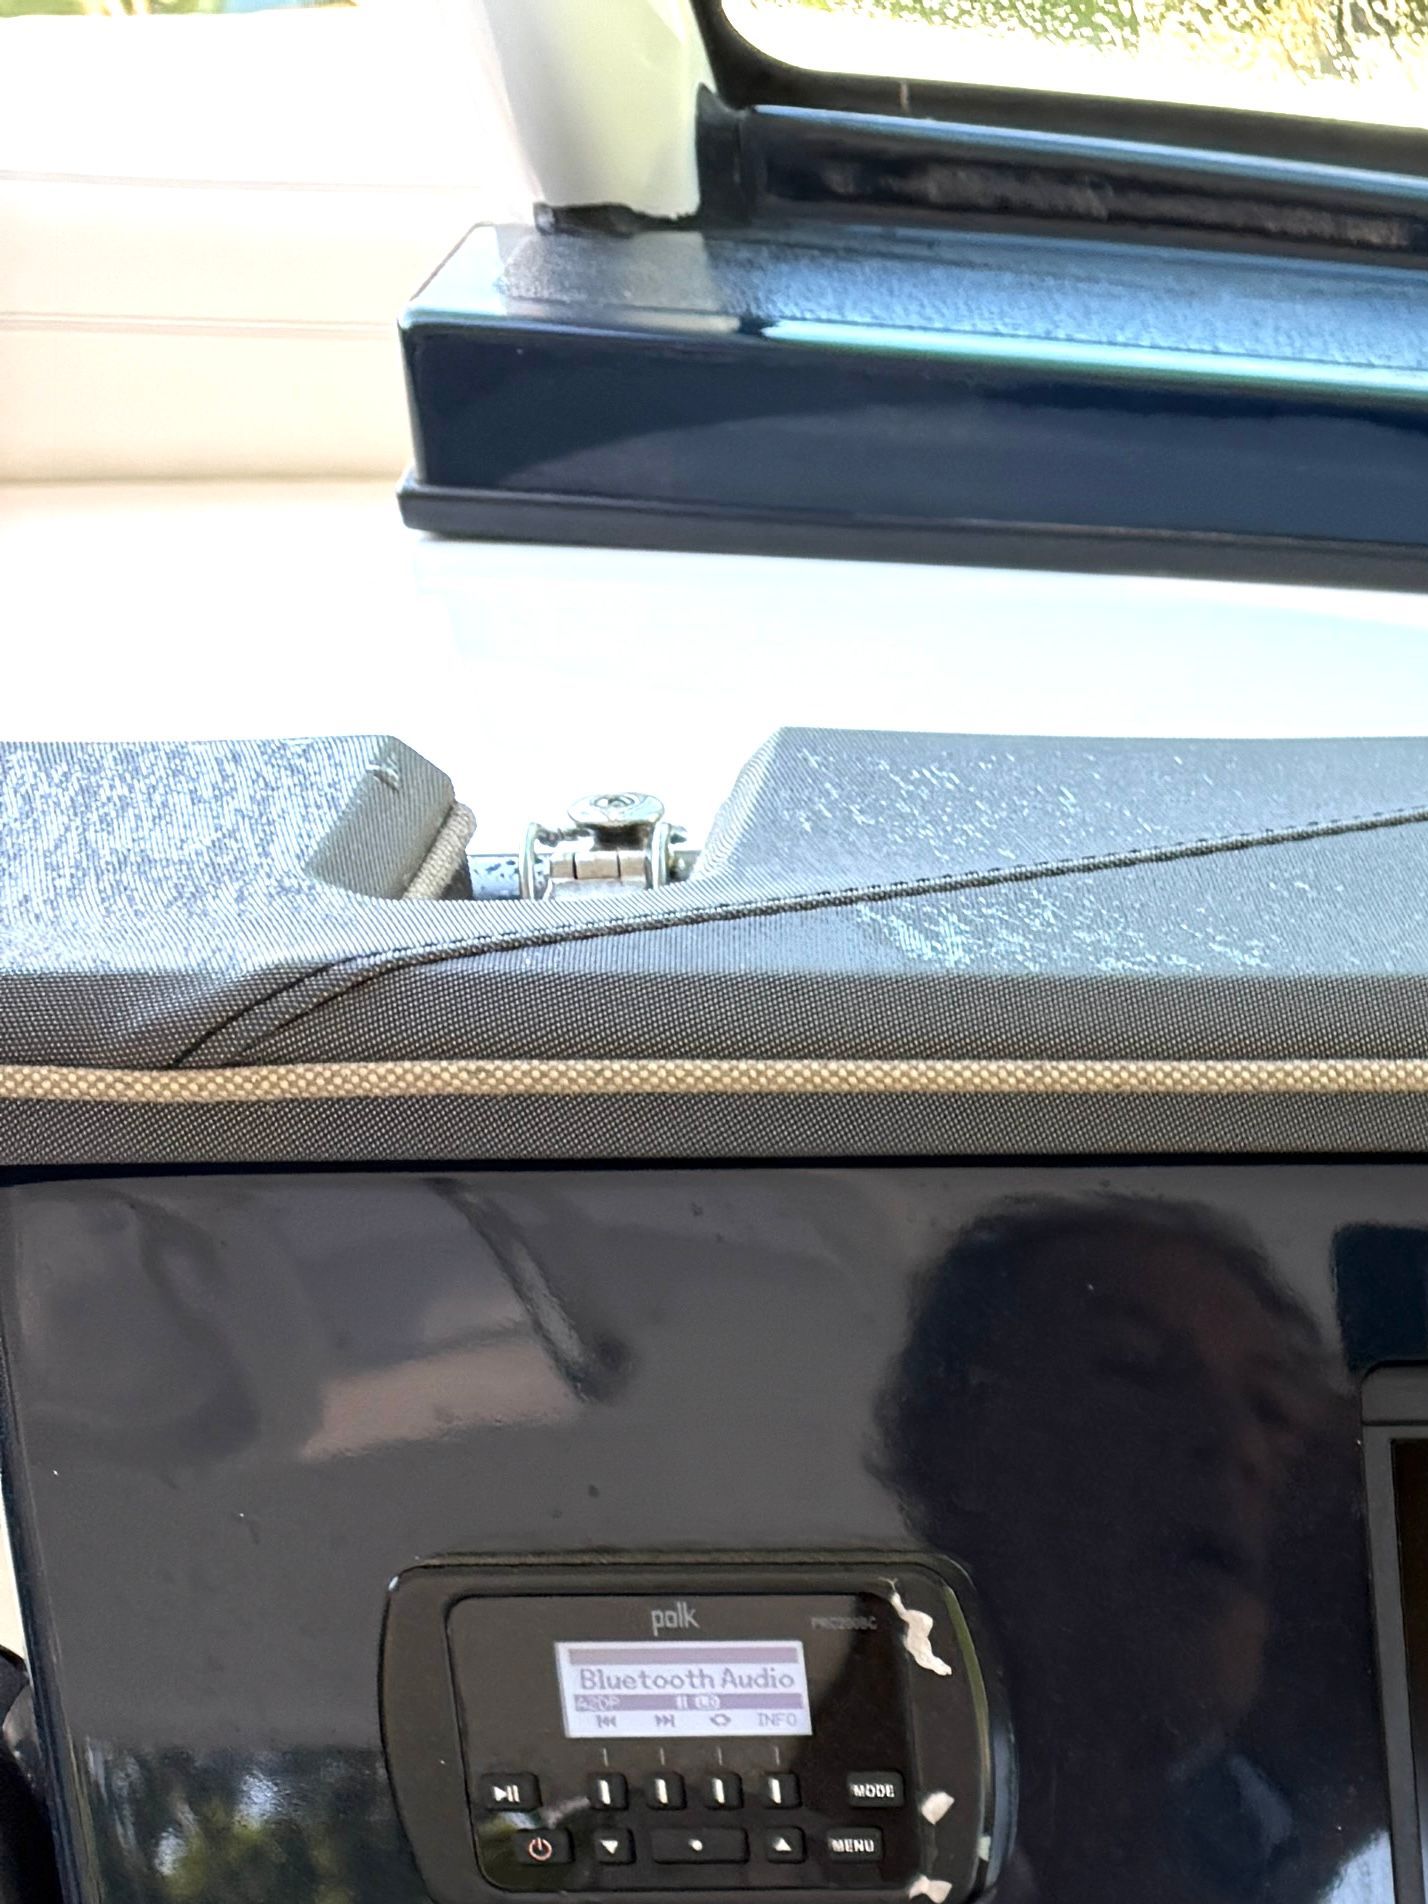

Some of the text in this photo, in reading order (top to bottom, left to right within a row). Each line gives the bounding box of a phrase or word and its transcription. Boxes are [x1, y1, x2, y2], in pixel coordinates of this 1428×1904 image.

[650, 1601, 701, 1637] polk
[578, 1666, 796, 1692] Bluetooth Audio
[756, 1712, 798, 1728] INFO
[850, 1783, 895, 1799] MODE
[831, 1838, 875, 1854] MENU
